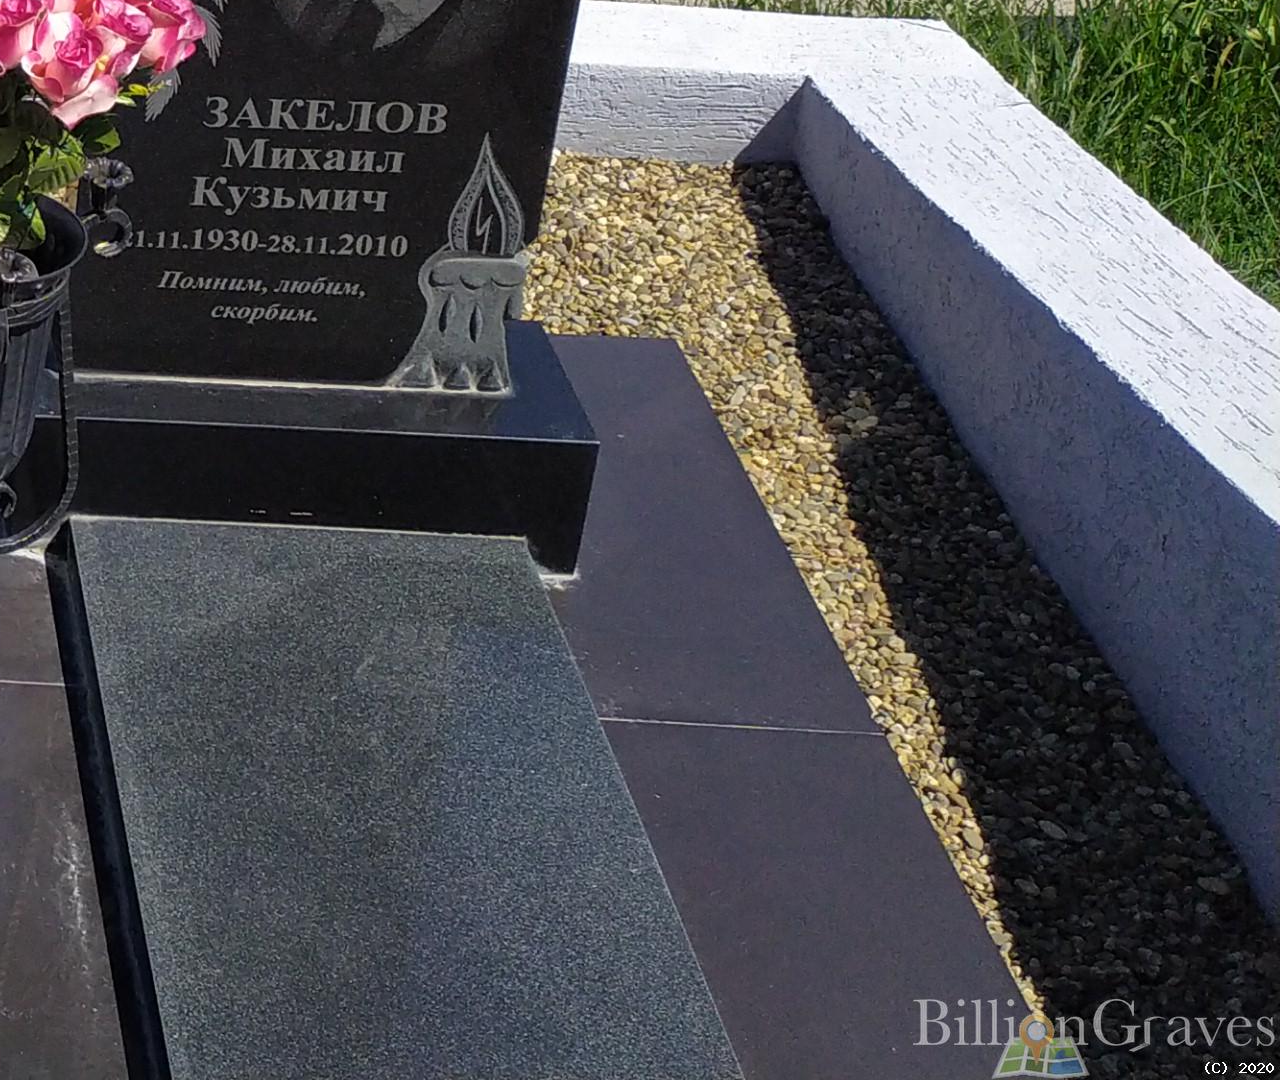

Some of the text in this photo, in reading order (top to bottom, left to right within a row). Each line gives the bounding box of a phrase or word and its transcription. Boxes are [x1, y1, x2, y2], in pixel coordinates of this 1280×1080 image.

[202, 95, 449, 135] ЗАКЕЛОВ
[221, 137, 406, 174] Михаил
[189, 176, 389, 217] Кузьмич
[157, 269, 368, 299] Помним, любим,
[210, 302, 319, 325] скорбим.
